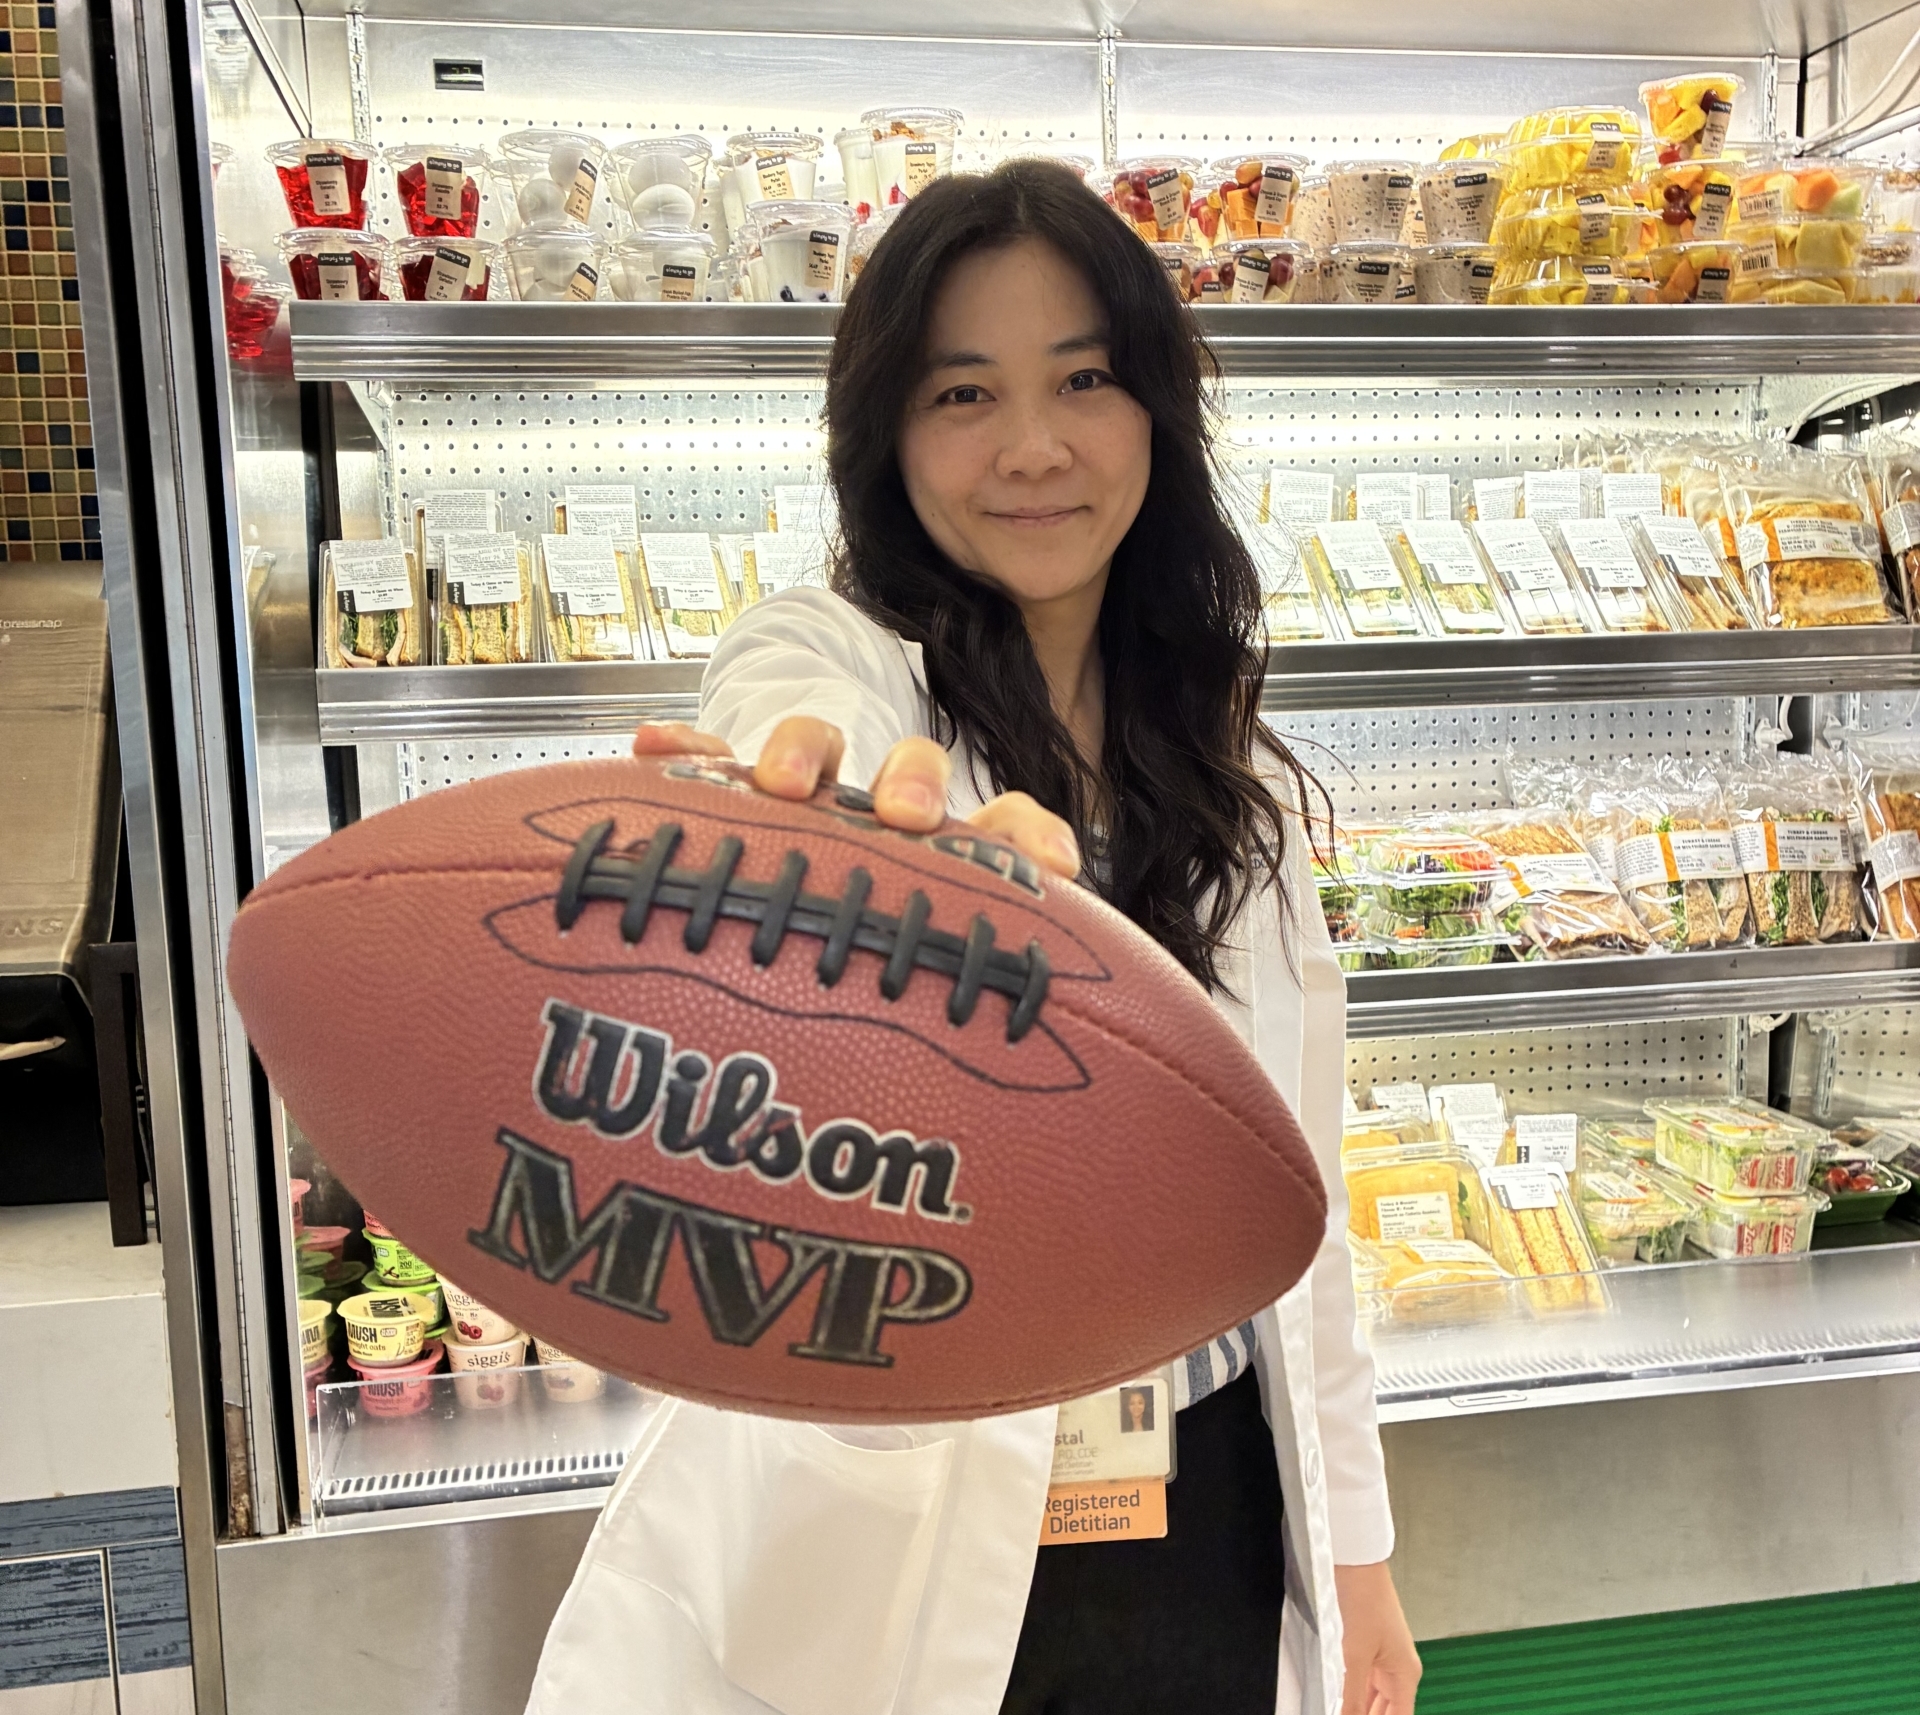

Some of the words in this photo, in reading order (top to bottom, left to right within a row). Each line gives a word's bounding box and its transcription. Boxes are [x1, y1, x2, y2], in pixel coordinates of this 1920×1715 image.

[1241, 257, 1256, 268] simply
[532, 997, 962, 1217] Wilson
[467, 1125, 974, 1368] MVP
[347, 1322, 378, 1343] MUSH
[467, 1351, 511, 1368] siggi's
[366, 1378, 404, 1397] MUSH
[1054, 1429, 1084, 1446] stal
[1045, 1489, 1140, 1516] Registered
[1050, 1514, 1131, 1534] Dietitian
